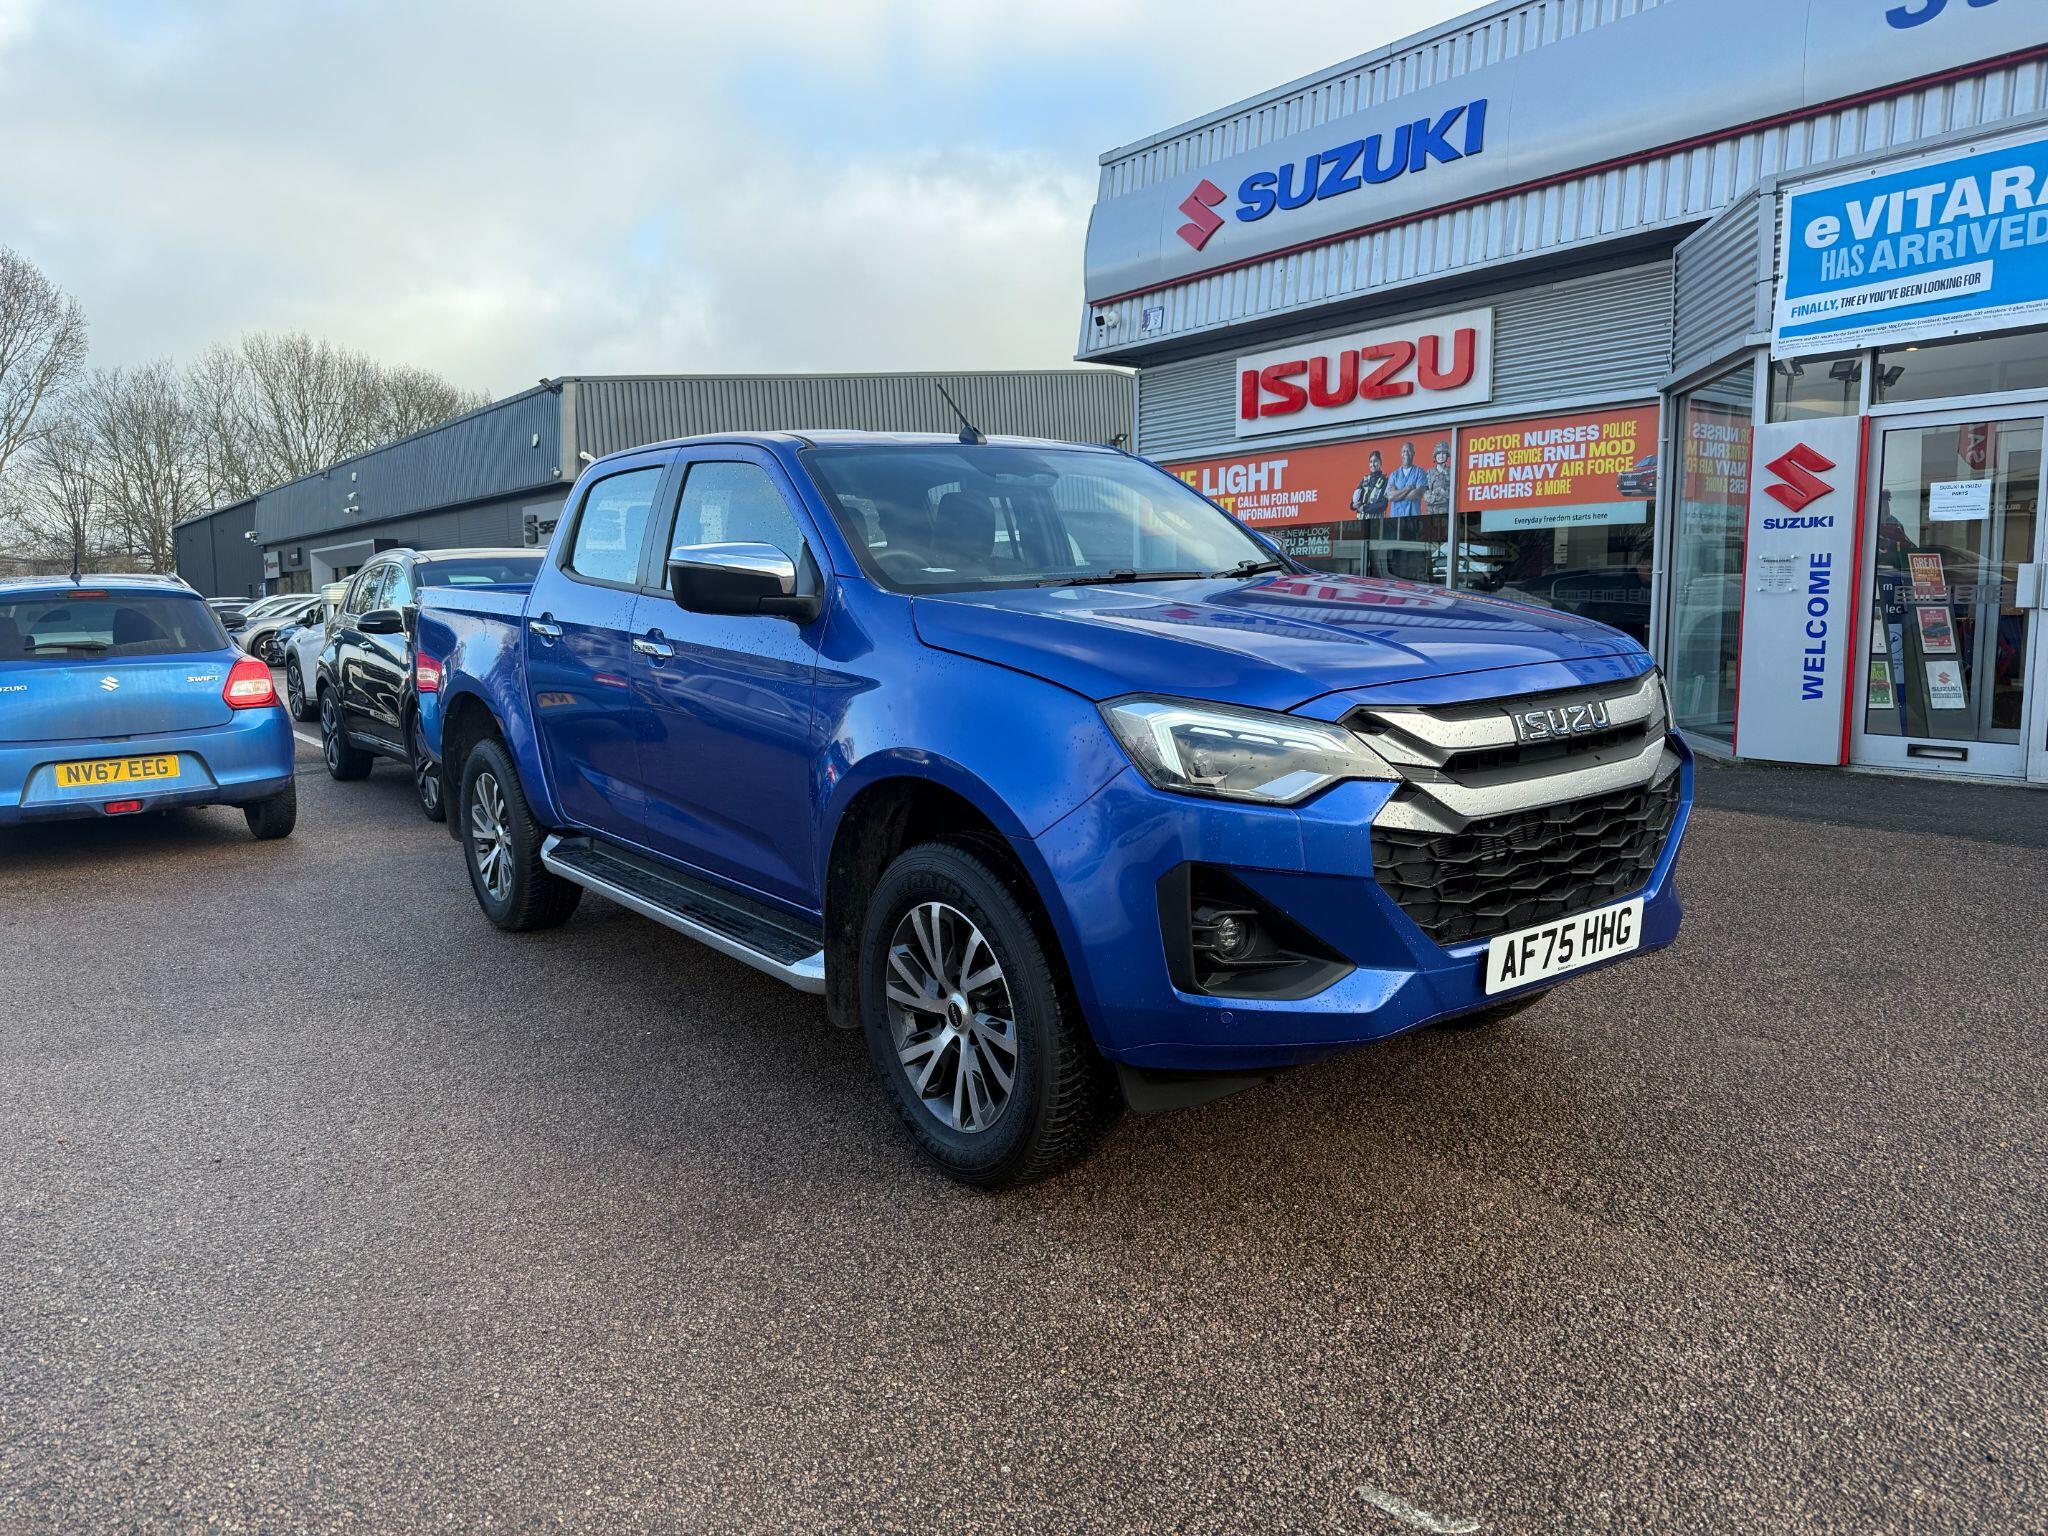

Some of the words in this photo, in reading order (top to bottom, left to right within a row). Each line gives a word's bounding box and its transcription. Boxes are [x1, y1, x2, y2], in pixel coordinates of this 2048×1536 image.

[1236, 99, 1487, 222] SUZUKI
[1821, 244, 1865, 282] HAS
[1868, 209, 2048, 274] ARRIVED
[1791, 299, 1840, 318] FINALLY,
[1840, 295, 1857, 309] THE
[1857, 294, 1868, 306] EV
[1869, 288, 1899, 303] YOU'VE
[1900, 284, 1922, 299] BEEN
[1923, 276, 1962, 294] LOOKING
[1963, 272, 1982, 287] FOR
[1242, 328, 1475, 420] ISUZU
[1469, 434, 1520, 453] DOCTOR
[1524, 425, 1600, 447] NURSES
[1602, 420, 1637, 439] POLICE
[1468, 452, 1505, 469] FIRE
[1508, 448, 1542, 465] SERVICE
[1543, 443, 1585, 462] RNLI
[1589, 439, 1636, 458] MOD
[1203, 459, 1289, 496] LIGHT
[1468, 468, 1506, 486] ARMY
[1508, 462, 1558, 482] NAVY
[1560, 461, 1584, 477] AIR
[1586, 456, 1634, 475] FORCE
[1237, 494, 1258, 508] CALL
[1260, 494, 1270, 507] IN
[1271, 492, 1290, 505] FOR
[1291, 490, 1317, 504] MORE
[1468, 482, 1533, 501] TEACHERS
[1536, 481, 1542, 496] &
[1544, 479, 1572, 495] MORE
[1237, 505, 1298, 521] INFORMATION
[1514, 517, 1543, 526] Everyday
[1544, 514, 1571, 523] freedom
[1572, 513, 1591, 521] starts
[1763, 516, 1834, 529] SUZUKI
[1287, 528, 1330, 537] NEW-LOOK
[1298, 536, 1329, 547] D-MAX
[1289, 546, 1330, 556] ARRIVED
[1913, 557, 1938, 569] GREAT
[1801, 552, 1833, 701] WELCOME
[0, 685, 28, 693] ZUKI
[187, 675, 220, 683] SWIFT
[1515, 700, 1611, 741] ISUZU
[66, 761, 121, 783] NV67
[128, 759, 169, 777] EEG
[1500, 923, 1576, 983] AF75
[1582, 907, 1632, 957] HHG
